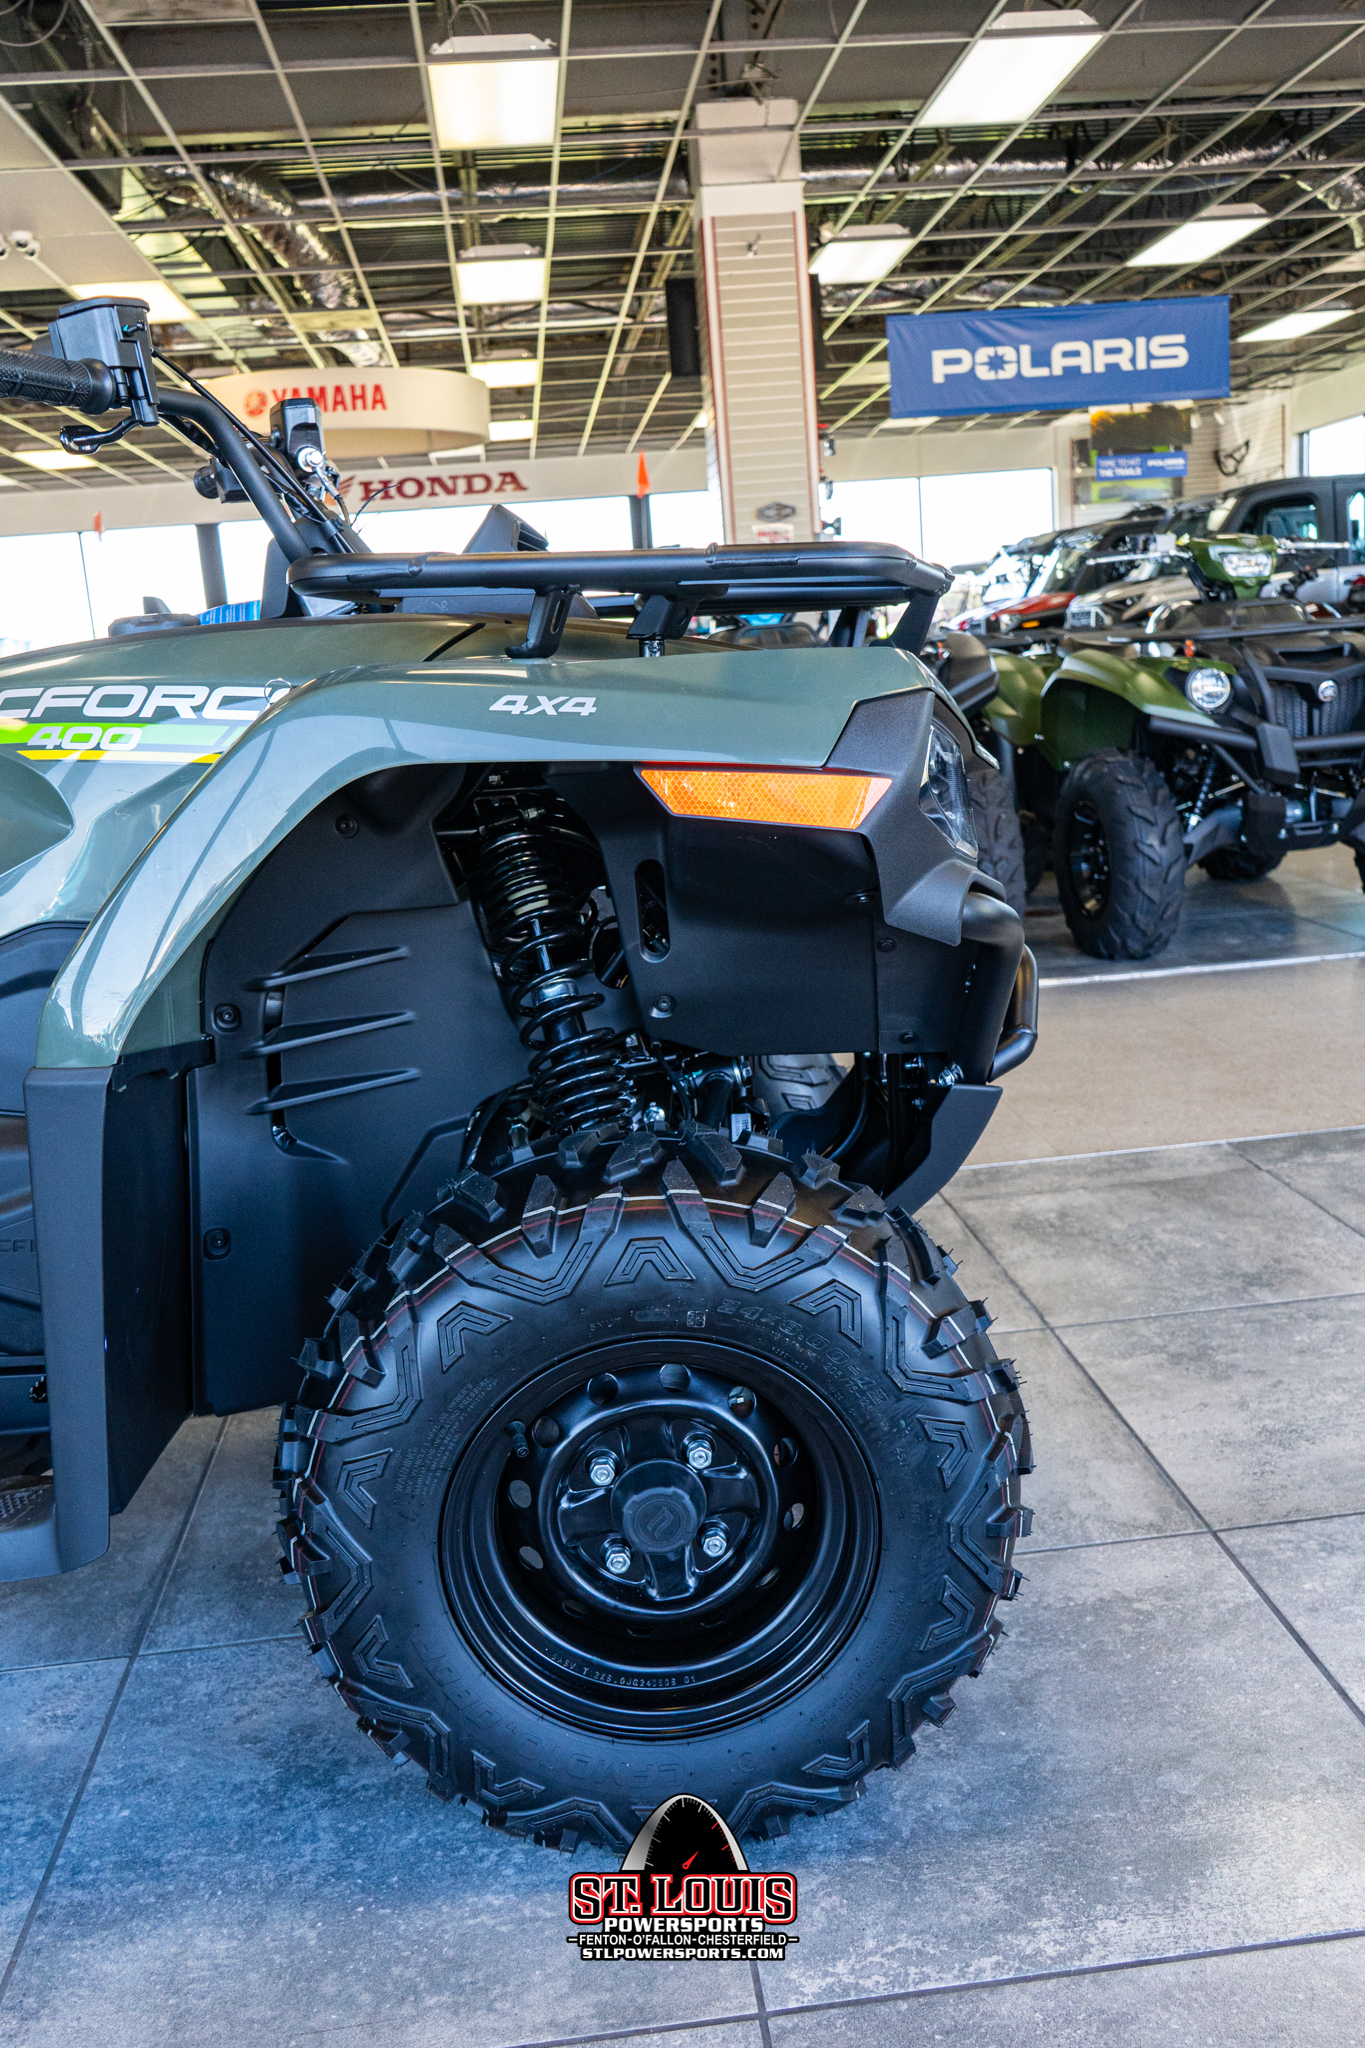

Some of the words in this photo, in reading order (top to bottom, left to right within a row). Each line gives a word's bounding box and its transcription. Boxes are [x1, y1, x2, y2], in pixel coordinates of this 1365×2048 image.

[931, 334, 1189, 383] POLARIS
[359, 471, 528, 501] HONDA
[489, 695, 597, 716] 4X4
[27, 726, 142, 750] 400
